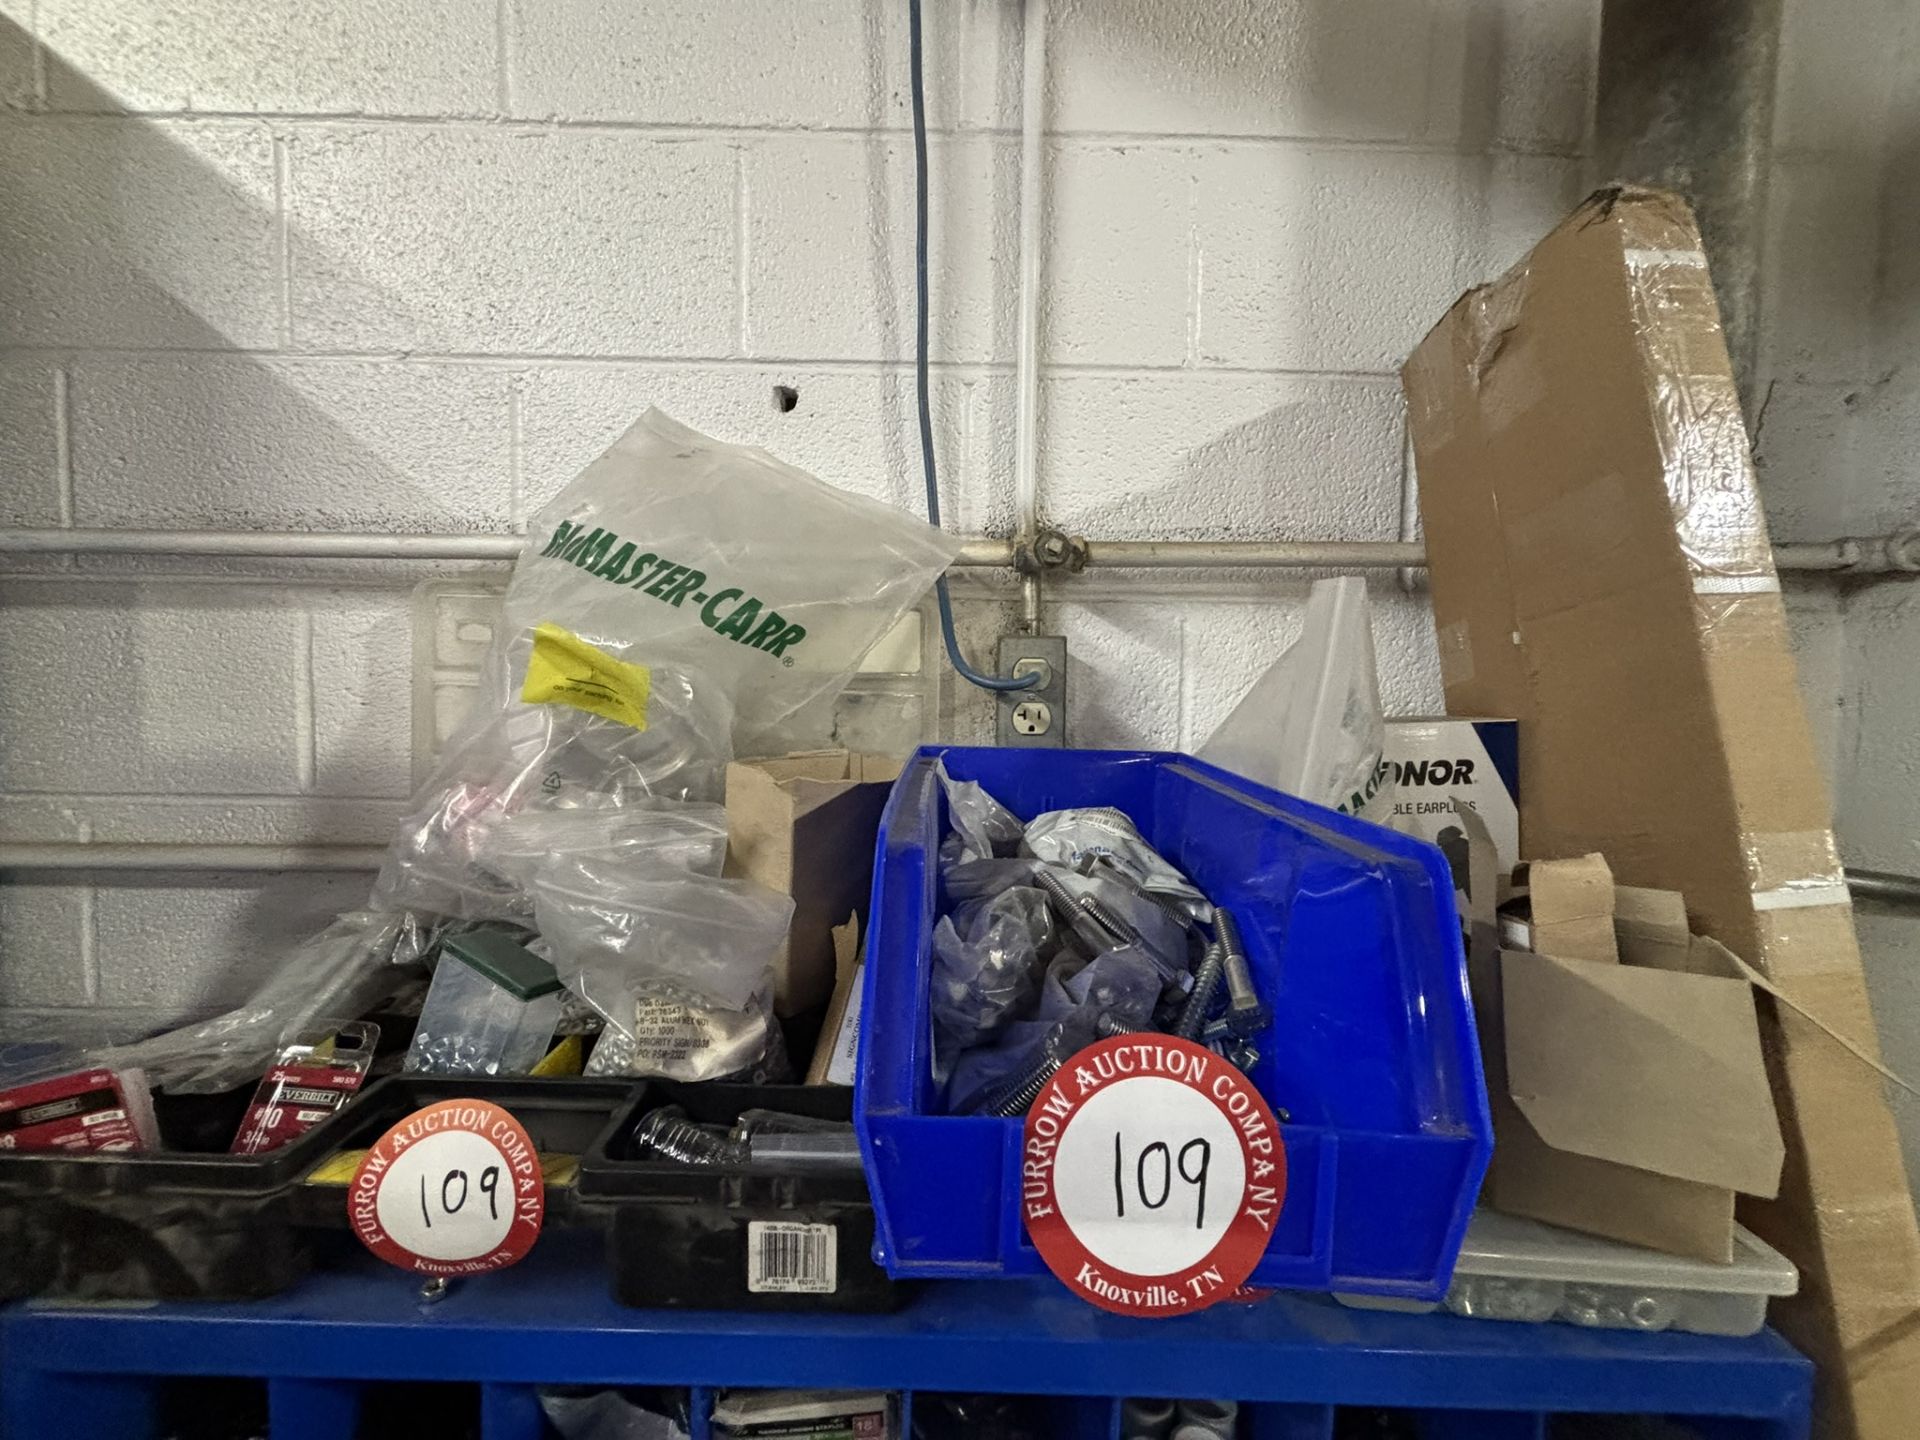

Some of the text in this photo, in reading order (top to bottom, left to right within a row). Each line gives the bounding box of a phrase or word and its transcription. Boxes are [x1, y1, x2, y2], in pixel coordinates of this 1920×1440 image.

[1416, 800, 1477, 815] EARPLS
[1023, 1045, 1278, 1232] FURROW AUCTION COMPANY
[354, 1107, 541, 1245] FURROW AUCTION COMPANY
[420, 1165, 500, 1228] 109
[1113, 1131, 1211, 1230] 109
[413, 1248, 513, 1274] Knoxville, TN
[1074, 1261, 1225, 1307] Knoxville, TN
